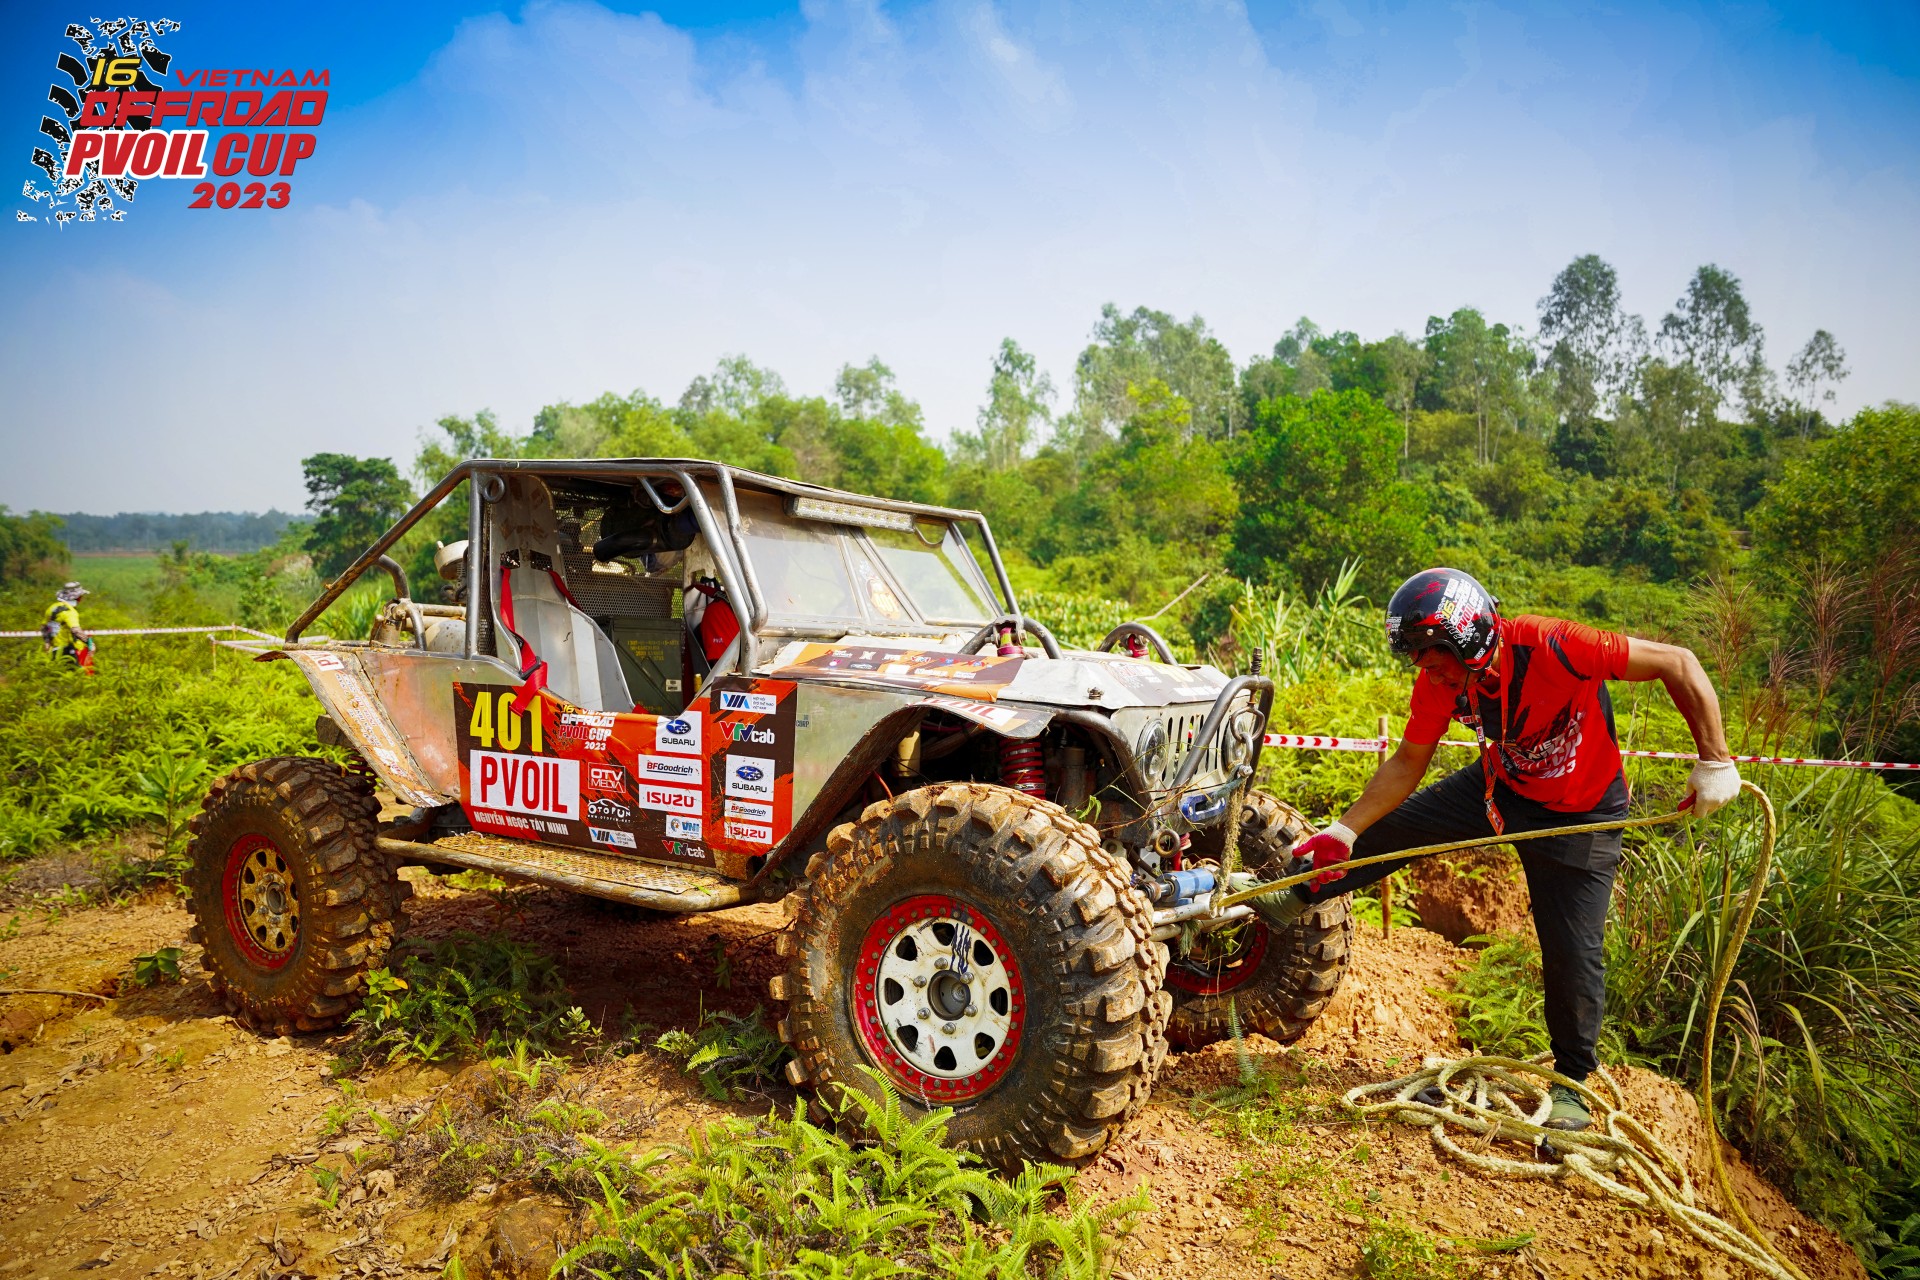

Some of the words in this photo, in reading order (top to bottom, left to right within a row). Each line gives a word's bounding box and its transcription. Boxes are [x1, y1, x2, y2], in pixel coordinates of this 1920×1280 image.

[470, 691, 543, 752] 401
[561, 713, 616, 728] OFFROAD
[559, 725, 589, 740] PVOIL
[588, 727, 613, 741] CUP
[584, 741, 606, 751] 2023
[661, 737, 696, 747] SUBARU
[591, 768, 624, 781] OTV
[646, 761, 694, 774] BFGoodrich
[480, 756, 568, 814] PVOIL
[731, 782, 768, 793] SUBARU
[646, 791, 695, 808] ISUZU
[546, 821, 569, 836] NINH
[729, 826, 767, 839] ISUZU
